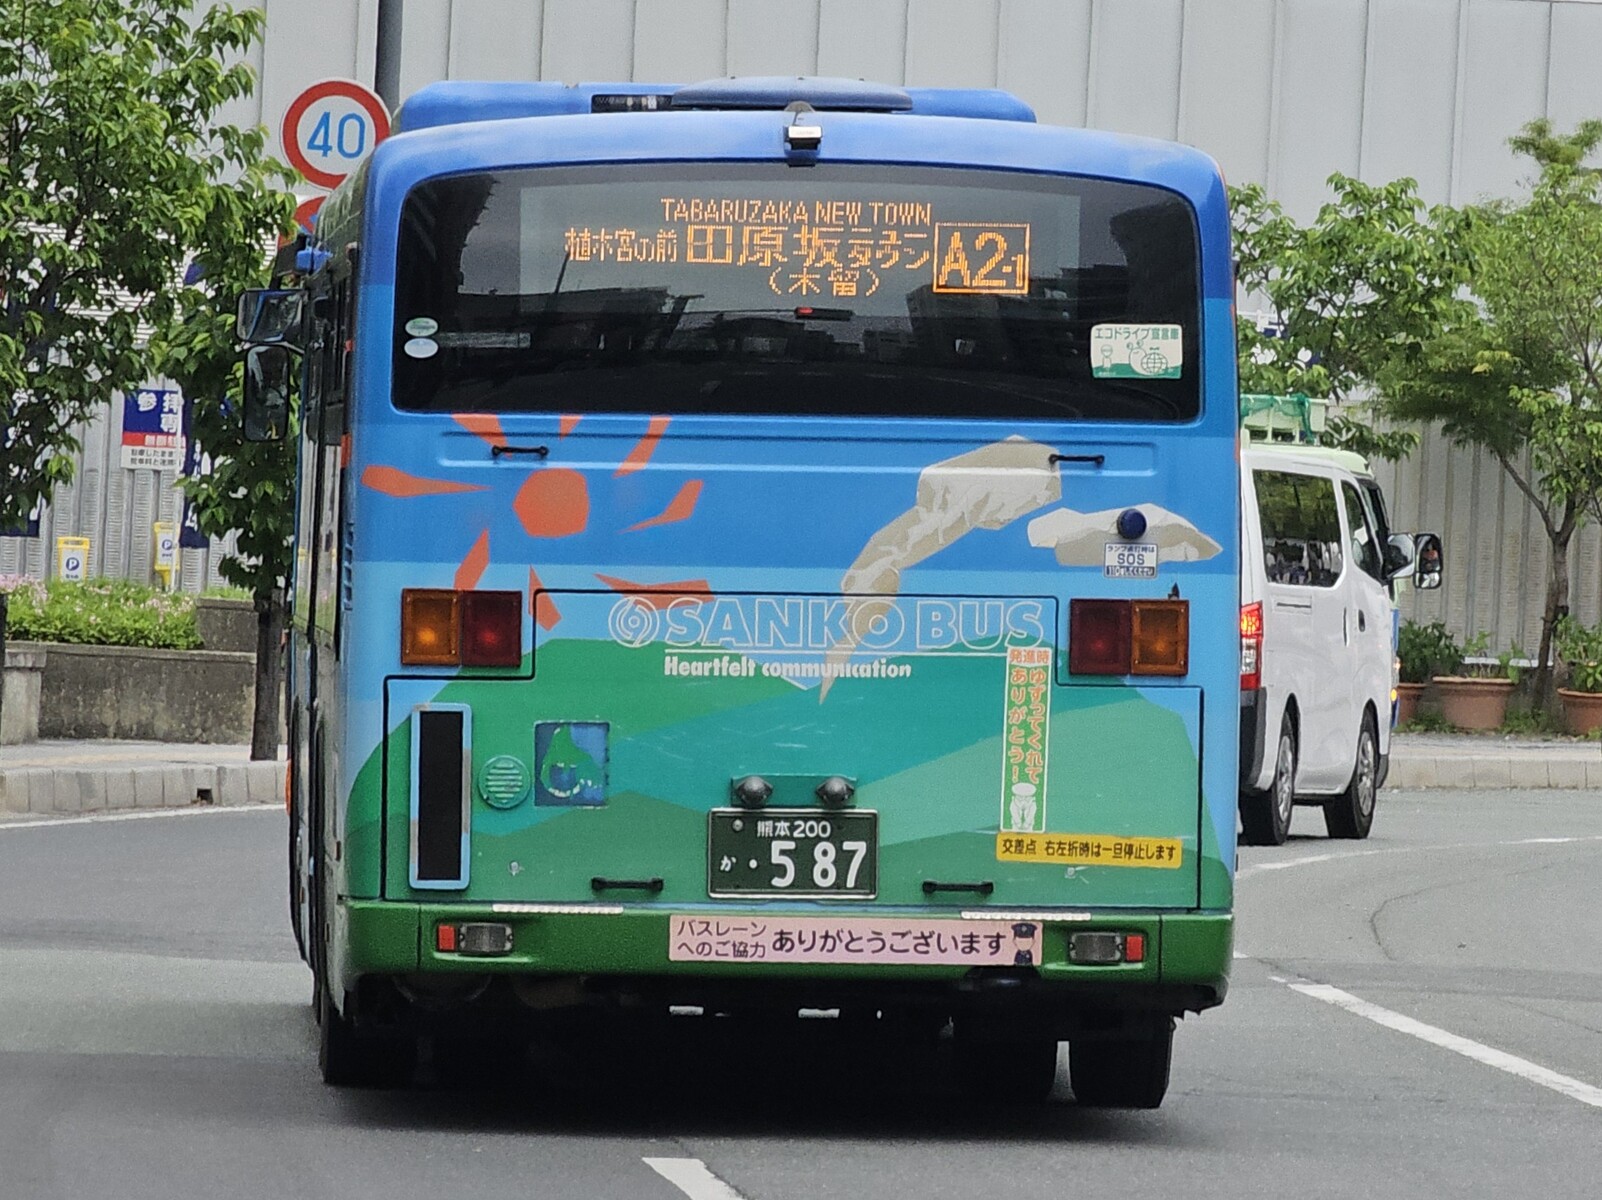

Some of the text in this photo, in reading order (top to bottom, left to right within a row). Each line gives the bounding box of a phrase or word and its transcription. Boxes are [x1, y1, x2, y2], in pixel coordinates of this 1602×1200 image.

[306, 111, 366, 159] 40
[660, 198, 931, 226] TABARUZAKA NEW TOWN
[564, 227, 678, 263] 植木宮の前
[1116, 553, 1146, 566] SOS
[664, 597, 1044, 650] SANKO BUS
[664, 655, 912, 679] Heartfelt communication
[1026, 667, 1046, 785] ゆずってくれて
[1002, 838, 1037, 856] 交差点
[719, 855, 737, 872] か
[677, 919, 767, 937] バスレーン
[677, 940, 767, 959] へのご協力
[772, 929, 1007, 956] ありがとうございます
